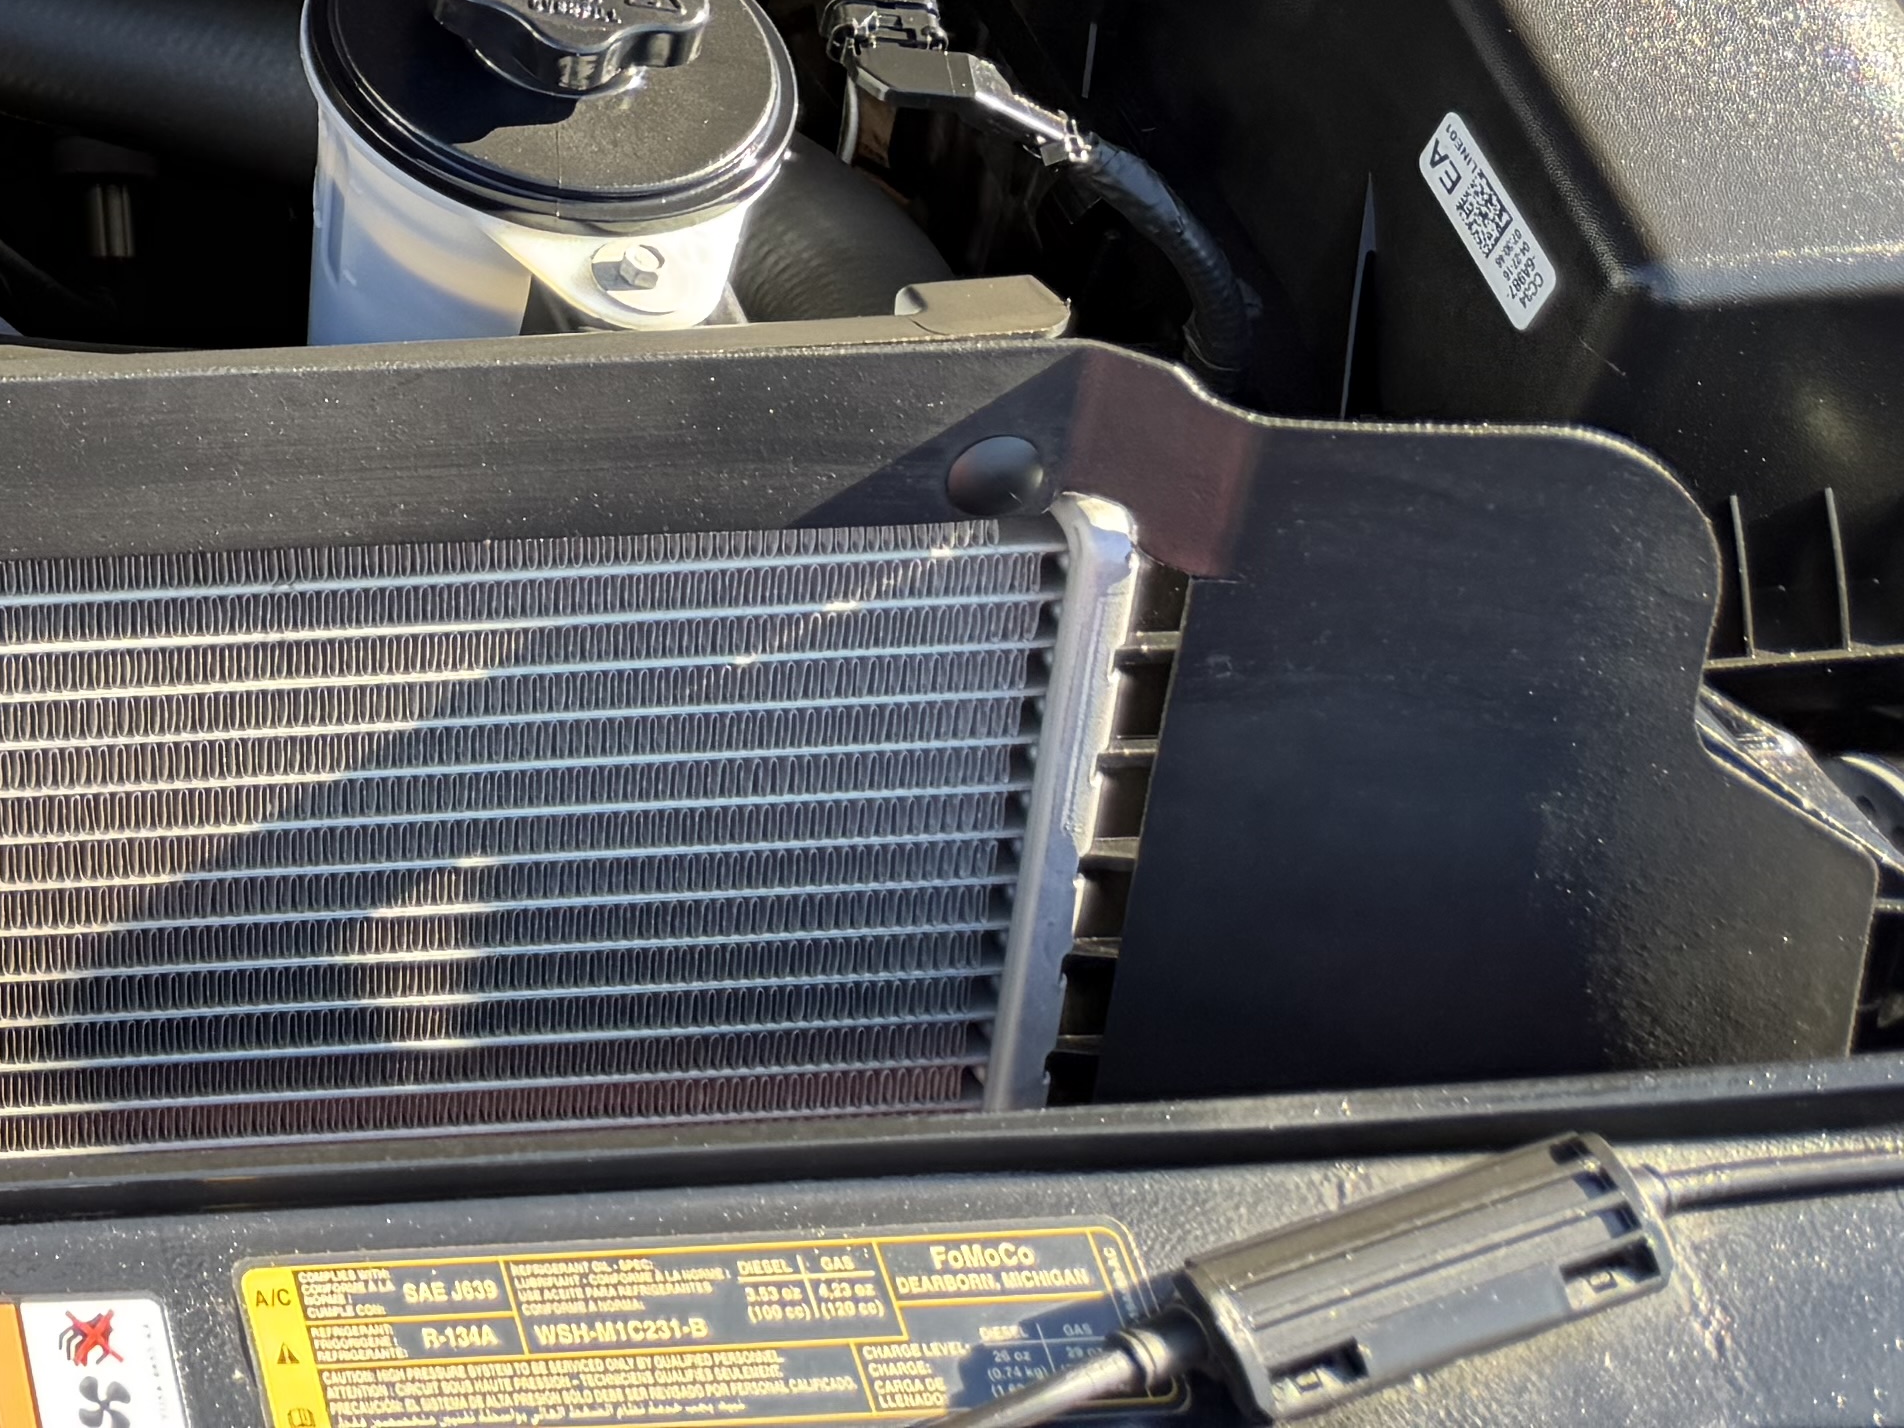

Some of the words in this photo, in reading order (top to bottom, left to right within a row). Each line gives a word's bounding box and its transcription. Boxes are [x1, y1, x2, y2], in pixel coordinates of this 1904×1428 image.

[1445, 123, 1478, 177] LINE01
[1429, 137, 1462, 195] EA
[819, 1255, 856, 1272] GAS
[929, 1241, 1036, 1270] FoMoCo
[664, 1269, 682, 1282] LA
[737, 1258, 794, 1275] DIESEL
[403, 1280, 449, 1304] SAE
[450, 1278, 500, 1302] J639
[853, 1283, 876, 1297] oz
[895, 1273, 1001, 1295] DEARBORN,
[1000, 1266, 1090, 1289] MICHIGAN
[255, 1288, 292, 1307] A/C
[744, 1285, 781, 1303] 3.53
[781, 1285, 803, 1301] oz
[747, 1304, 783, 1325] (100
[784, 1302, 811, 1321] cc)
[820, 1300, 856, 1321] (120
[857, 1298, 885, 1318] cc)
[421, 1323, 502, 1350] R-134A
[533, 1316, 709, 1345] WSH-M1C231-B
[979, 1325, 1029, 1341] DIESEL
[1062, 1322, 1093, 1337] GAS
[862, 1342, 922, 1361] CHARGE
[1014, 1350, 1032, 1362] oz
[375, 1368, 405, 1384] HIGH
[405, 1364, 467, 1381] PRESSURE
[467, 1362, 514, 1379] SYSTEM
[513, 1361, 531, 1376] TO
[530, 1360, 549, 1376] BE
[548, 1357, 605, 1375] SERVICED
[604, 1356, 635, 1372] ONLY
[635, 1355, 653, 1370] BY
[653, 1352, 714, 1369] QUALIFIED
[867, 1360, 932, 1378] CHARGE:
[394, 1380, 440, 1398] CIRCUIT
[441, 1379, 474, 1395] SOUS
[473, 1377, 514, 1394] HAUTE
[513, 1375, 571, 1391] PRESSION
[578, 1370, 655, 1387] TECHNICIENS
[873, 1377, 925, 1394] CARGA
[925, 1376, 947, 1392] DE
[420, 1395, 470, 1412] SISTEMA
[469, 1394, 485, 1410] DE
[485, 1392, 514, 1409] ALTA
[593, 1386, 625, 1403] DEBE
[624, 1385, 649, 1402] SER
[704, 1382, 730, 1397] POR
[729, 1379, 790, 1397] PERSONAL
